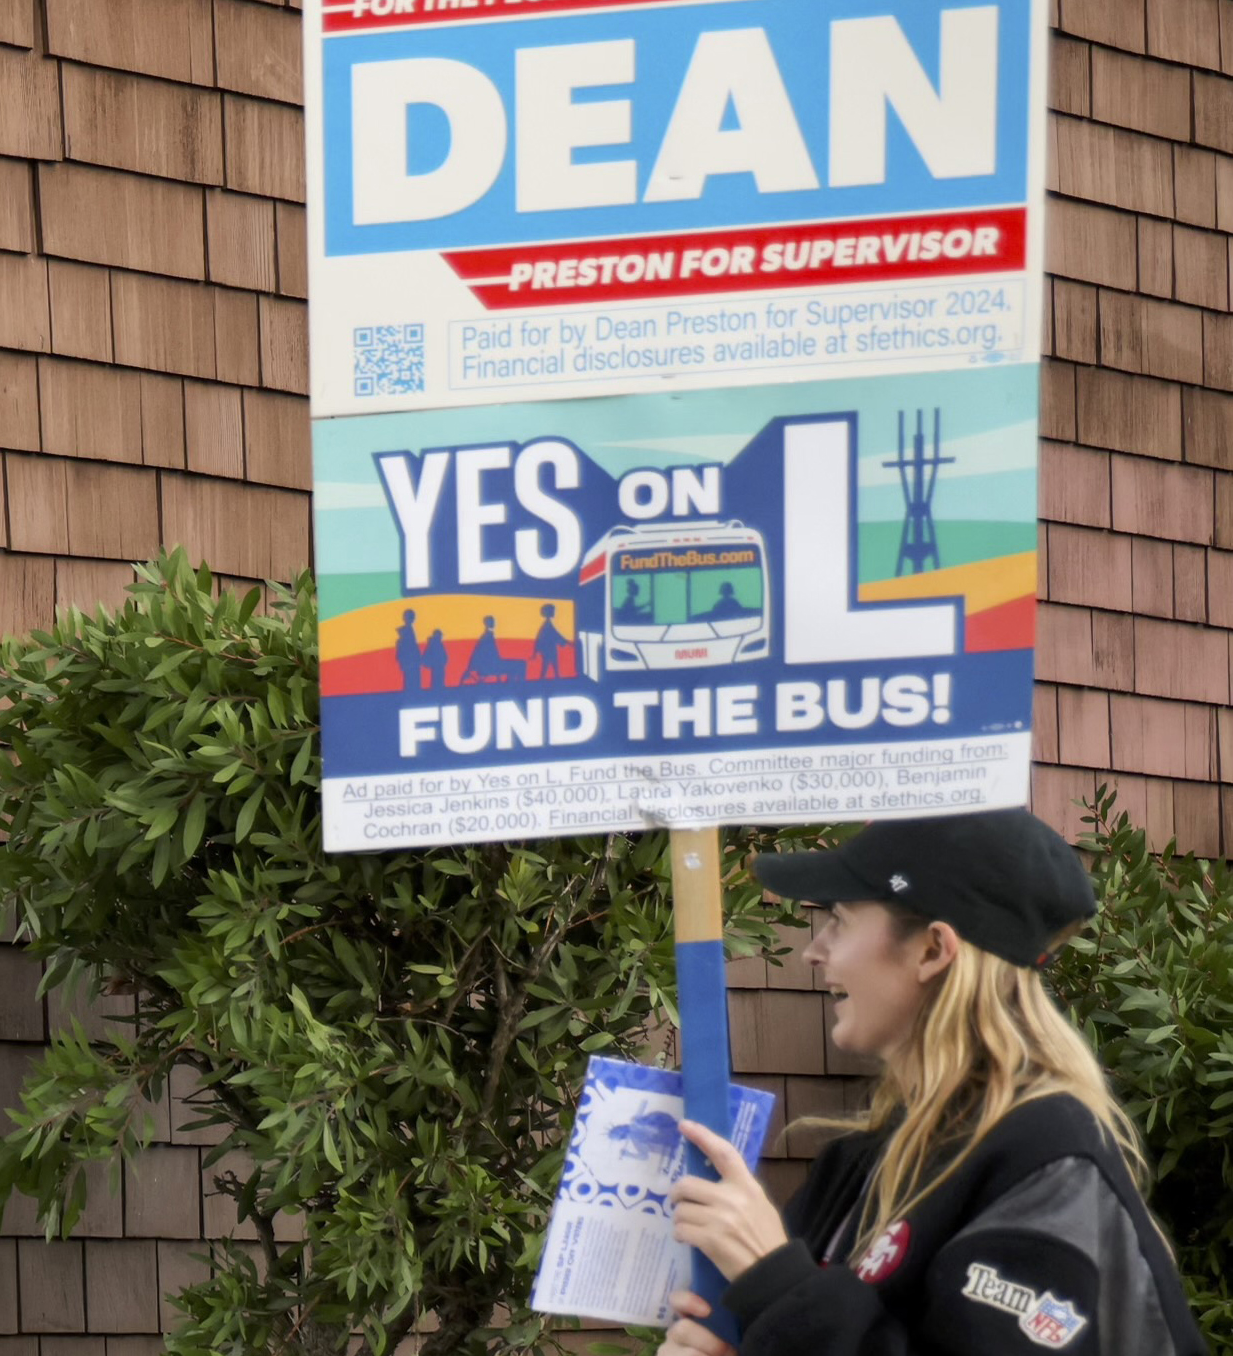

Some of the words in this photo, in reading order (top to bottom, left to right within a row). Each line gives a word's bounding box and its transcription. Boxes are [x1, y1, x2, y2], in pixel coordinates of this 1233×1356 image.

[351, 5, 999, 226] DEAN
[508, 250, 673, 292] PRESTON
[679, 243, 756, 278] FOR
[761, 226, 1000, 271] SUPERVISOR
[462, 323, 512, 350] Paid
[521, 320, 552, 344] for
[559, 318, 587, 348] by
[596, 316, 657, 341] Dean
[667, 305, 757, 335] Preston
[766, 303, 797, 328] for
[806, 294, 938, 330] Supervisor
[946, 289, 1012, 316] 2024.
[464, 350, 565, 379] Financial
[573, 343, 706, 372] disclosures
[713, 331, 817, 362] available
[825, 328, 848, 355] at
[856, 324, 1004, 352] sfethics.org.
[378, 441, 584, 590] YES
[618, 465, 721, 520] ON
[784, 421, 956, 664] L
[620, 549, 755, 570] FundTheBus.com
[399, 694, 598, 758] FUND
[613, 681, 759, 744] THE
[775, 673, 950, 732] BUS!
[343, 784, 367, 800] Ad
[375, 780, 414, 804] paid
[419, 778, 444, 796] for
[450, 775, 471, 797] by
[477, 772, 511, 790] Yes
[516, 772, 540, 787] on
[546, 768, 563, 787] L,
[570, 763, 617, 783] Fund
[623, 762, 652, 779] the
[660, 759, 700, 777] Bus.
[709, 751, 813, 775] Committee
[820, 748, 874, 772] major
[882, 742, 955, 768] funding
[961, 741, 1009, 761] from:
[364, 800, 433, 820] Jessica
[440, 792, 510, 814] Jenkins
[617, 780, 672, 802] Laura
[678, 773, 784, 798] Yakovenko
[790, 766, 888, 796] ($30,000),
[897, 763, 988, 788] Benjamin
[364, 821, 442, 840] Cochran
[448, 812, 542, 838] ($20,000).
[549, 804, 634, 827] Financial
[752, 790, 839, 815] available
[846, 790, 865, 809] at
[870, 785, 987, 808] sfethics.org.
[968, 1266, 1032, 1313] Team
